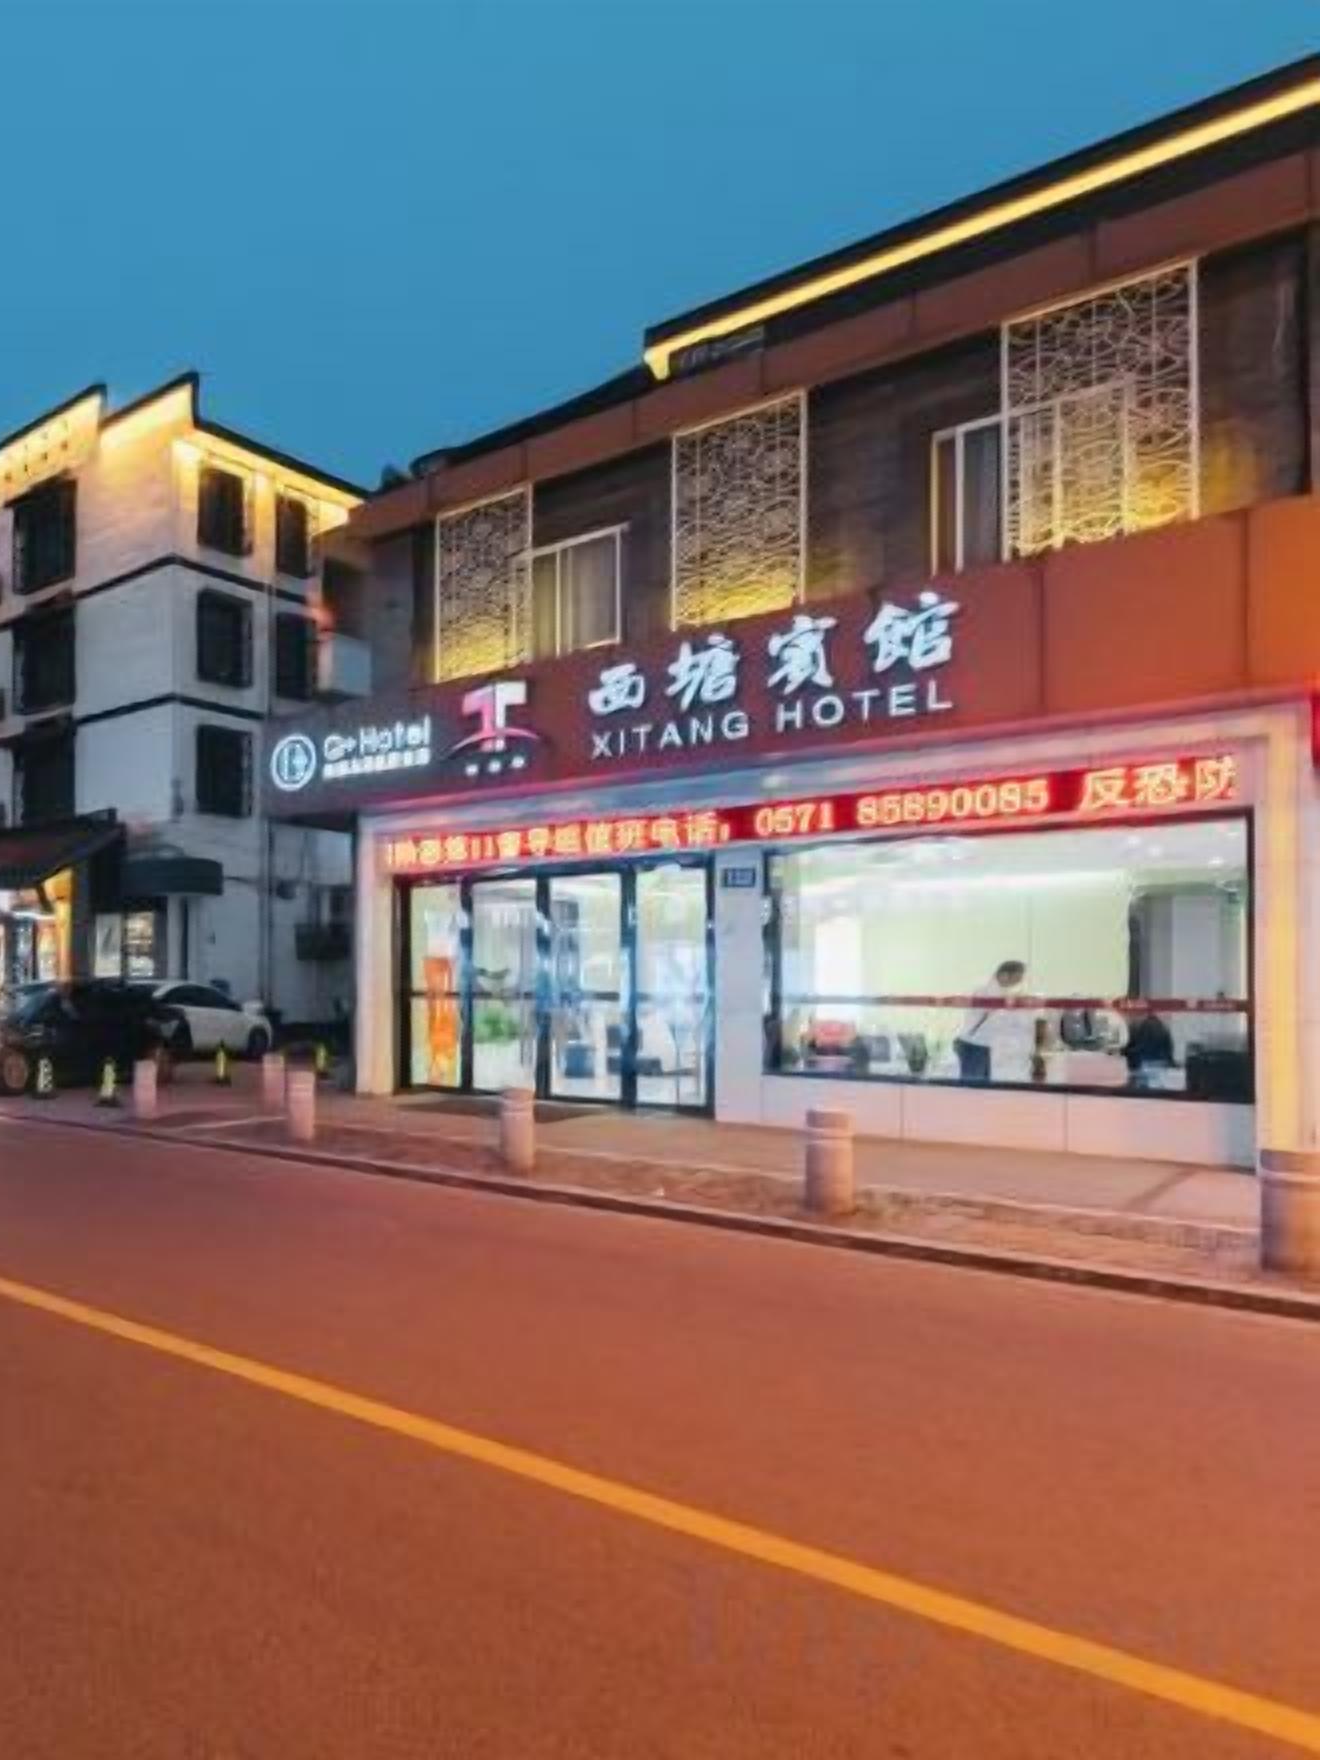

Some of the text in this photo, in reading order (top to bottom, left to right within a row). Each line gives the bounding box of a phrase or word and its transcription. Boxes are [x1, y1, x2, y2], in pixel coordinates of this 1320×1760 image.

[591, 679, 954, 760] XITANG HOTEL
[755, 801, 834, 836] 0571
